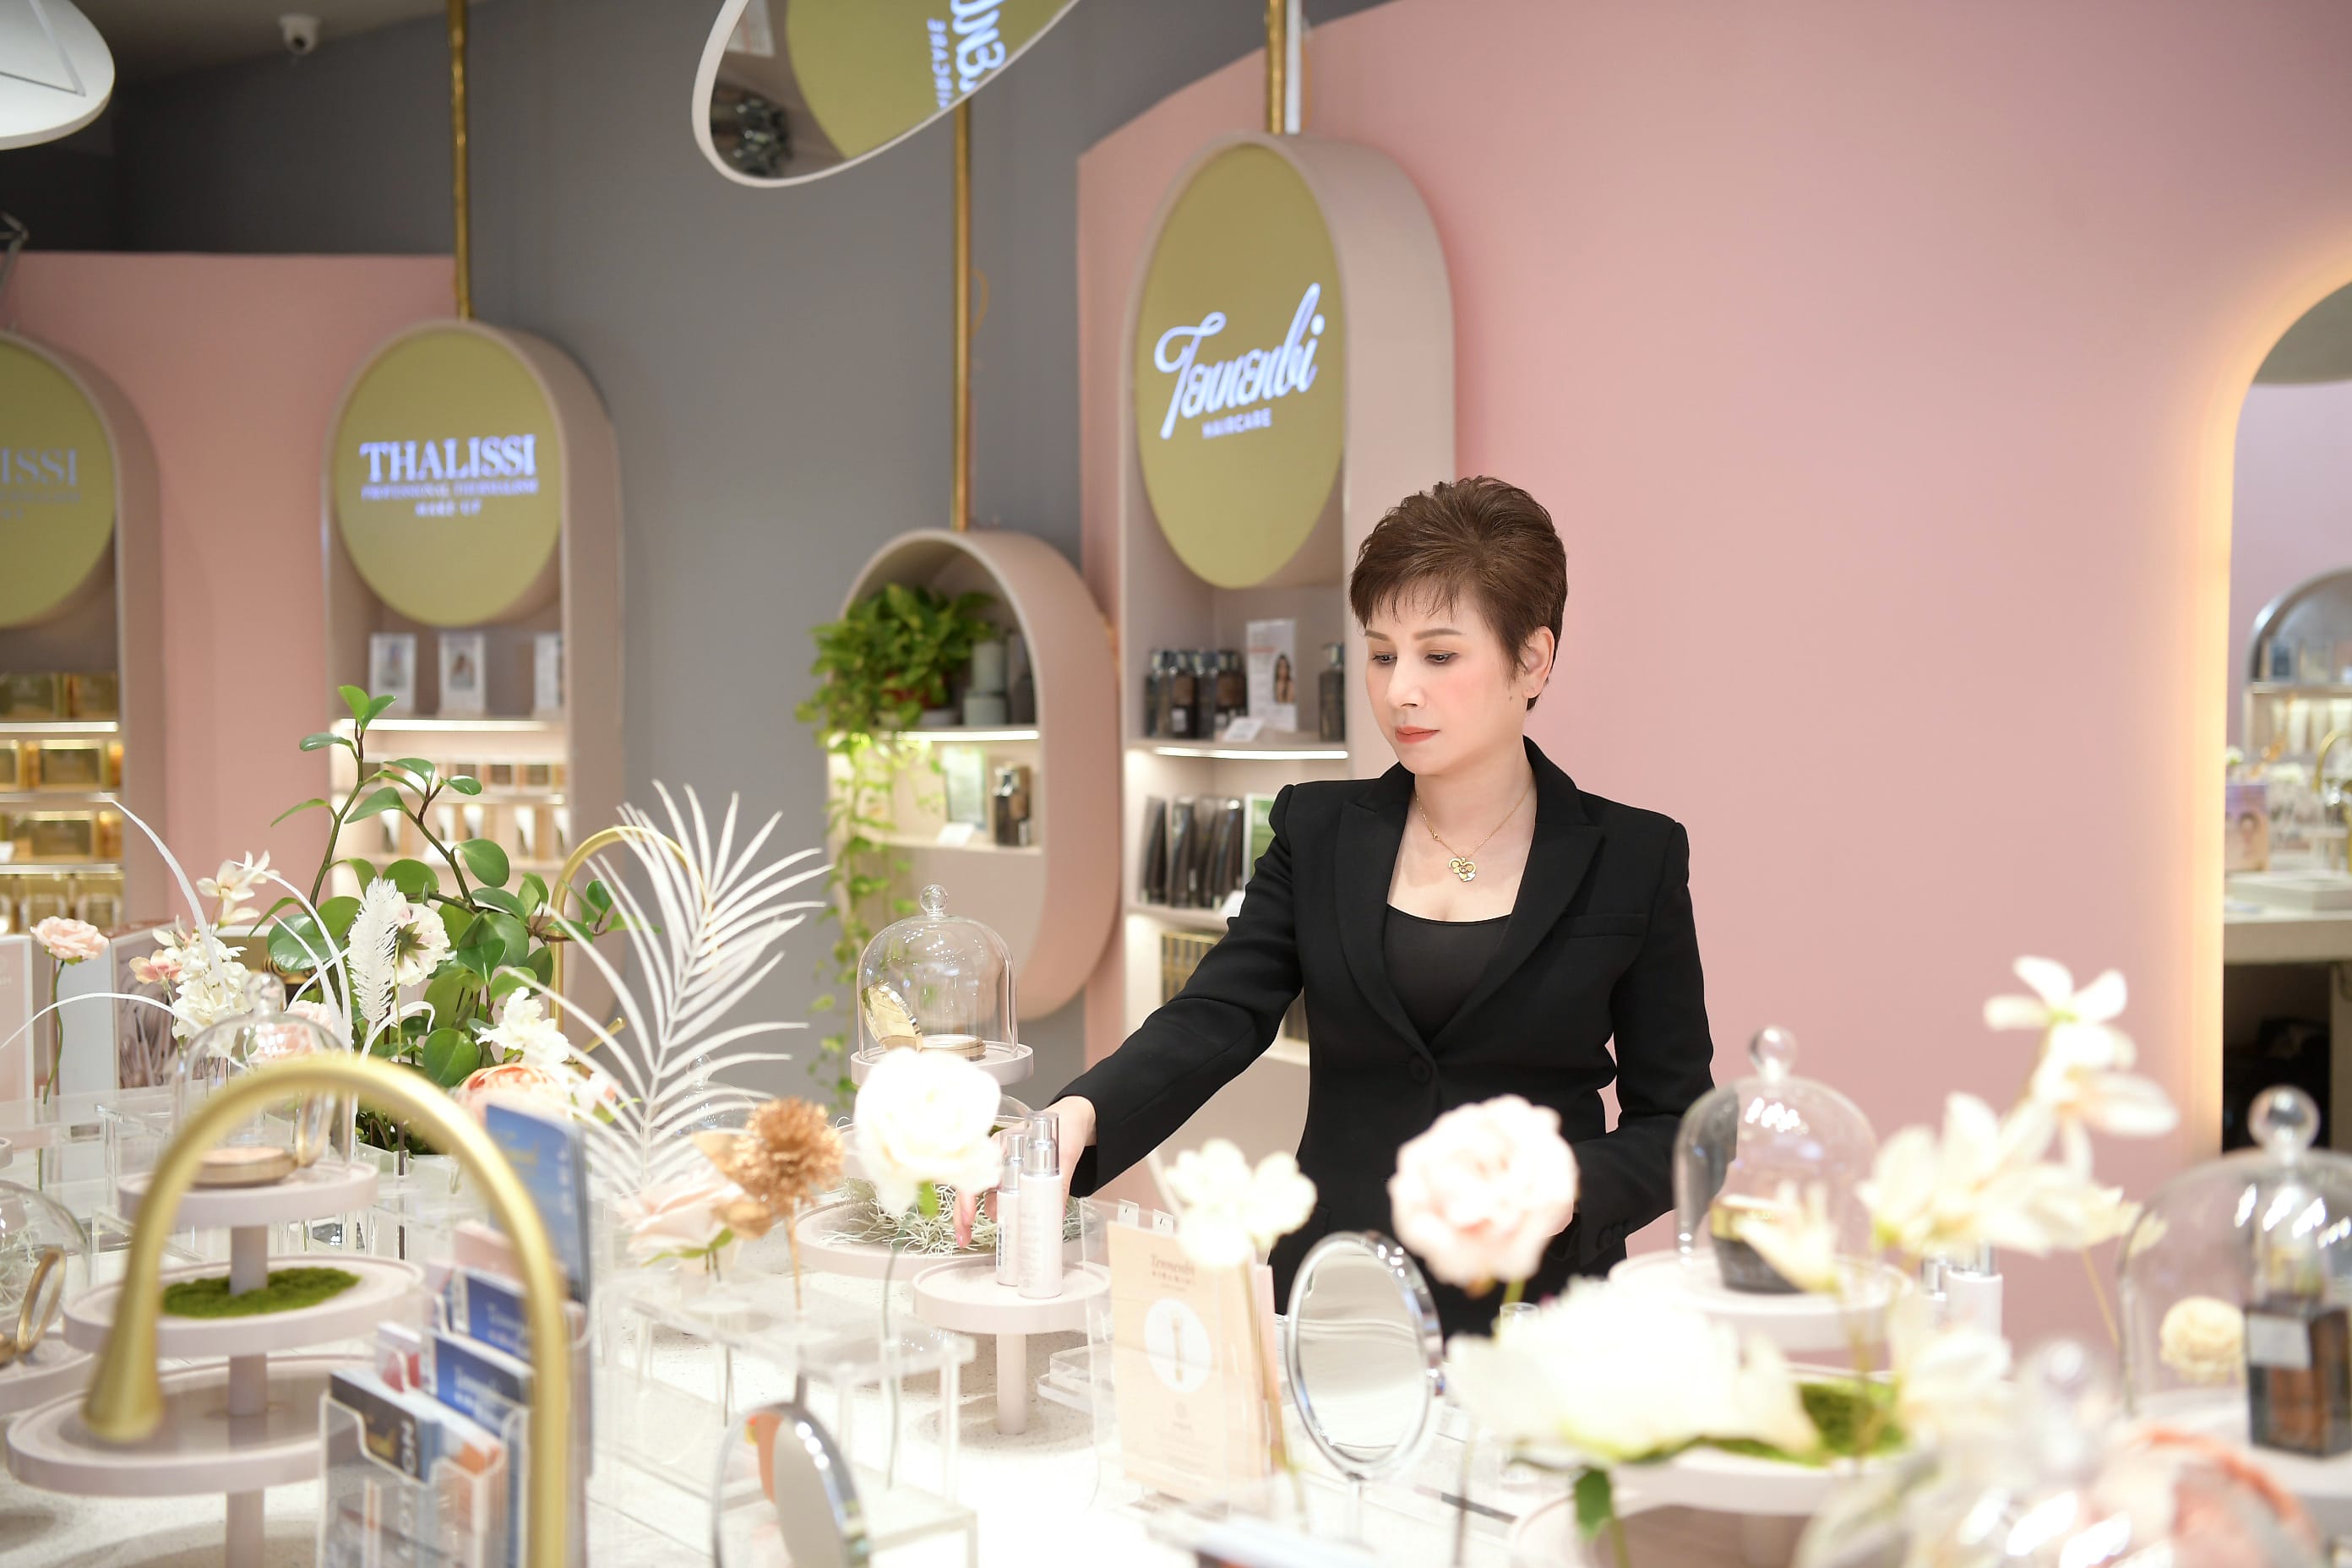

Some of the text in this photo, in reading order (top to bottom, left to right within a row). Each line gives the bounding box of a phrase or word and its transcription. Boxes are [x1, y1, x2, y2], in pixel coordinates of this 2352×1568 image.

[1201, 407, 1272, 439] HAIRCARE
[0, 447, 78, 487] ISSI
[359, 433, 536, 482] THALISSI
